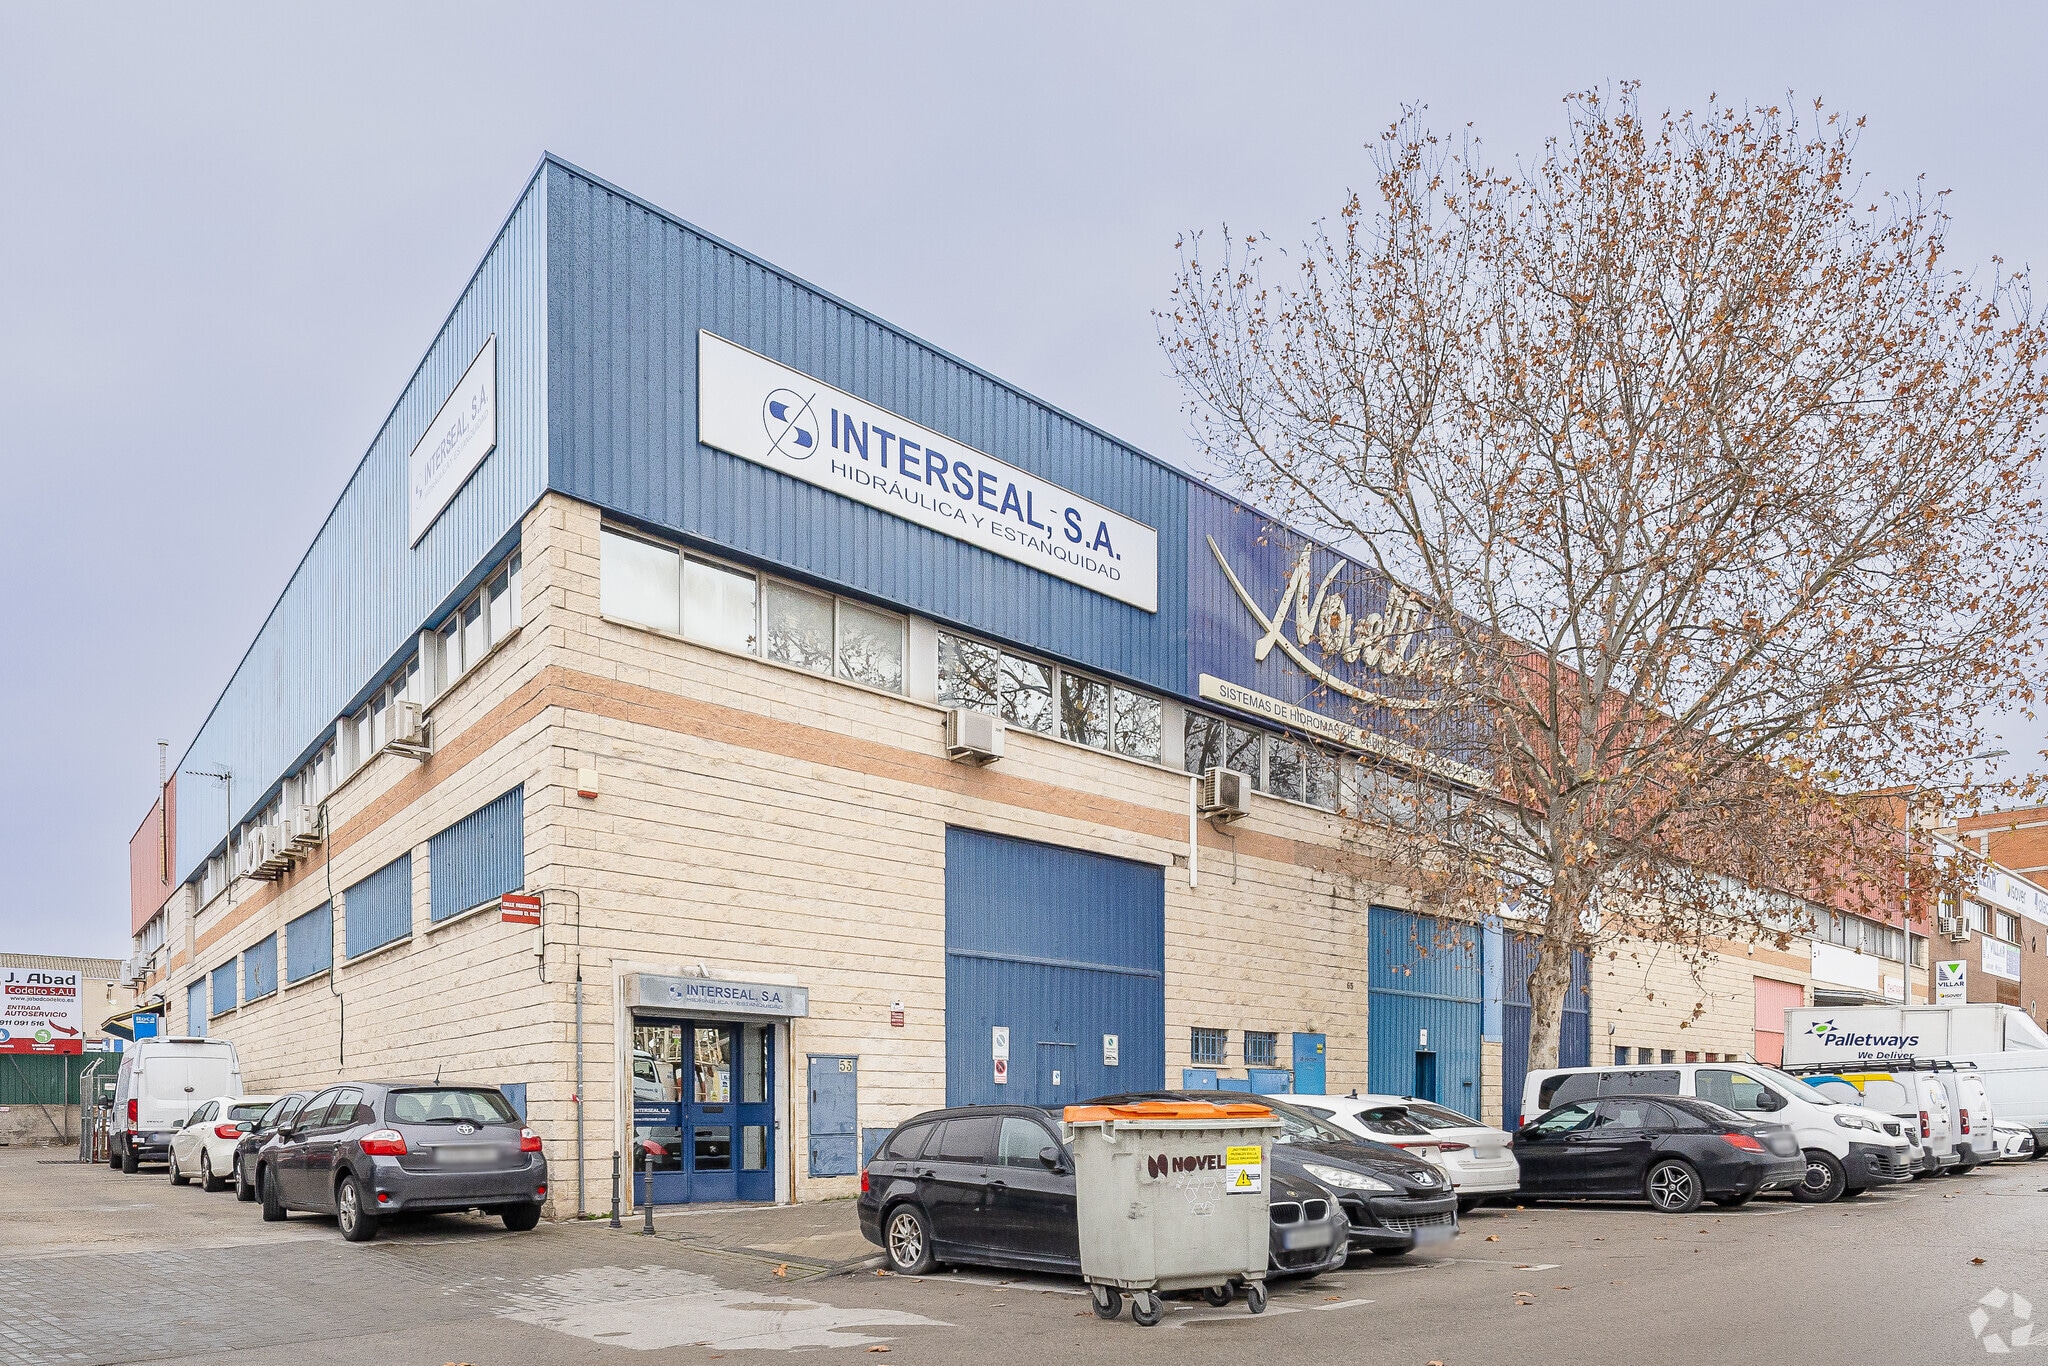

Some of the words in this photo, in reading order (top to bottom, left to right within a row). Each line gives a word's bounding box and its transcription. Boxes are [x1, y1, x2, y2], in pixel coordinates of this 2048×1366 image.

[471, 383, 489, 421] S.A.
[830, 408, 1054, 540] INTERSEAL,
[1064, 506, 1121, 561] S.A.
[831, 457, 966, 526] HIDRÁULICA
[971, 512, 985, 529] Y
[990, 521, 1121, 583] ESTANQUIDAD
[1219, 684, 1271, 713] SISTEMAS
[1274, 703, 1287, 719] DE
[5, 972, 20, 983] J.
[27, 973, 76, 985] Abad
[8, 986, 47, 995] Codelco
[761, 990, 784, 1004] S.A.
[4, 1010, 68, 1018] AUTOSERVICIO
[1824, 1032, 1919, 1048] Palletways
[1857, 1051, 1875, 1059] We
[1876, 1051, 1915, 1060] Deliver
[839, 1060, 853, 1072] 53
[1172, 1154, 1226, 1173] NOVEL
